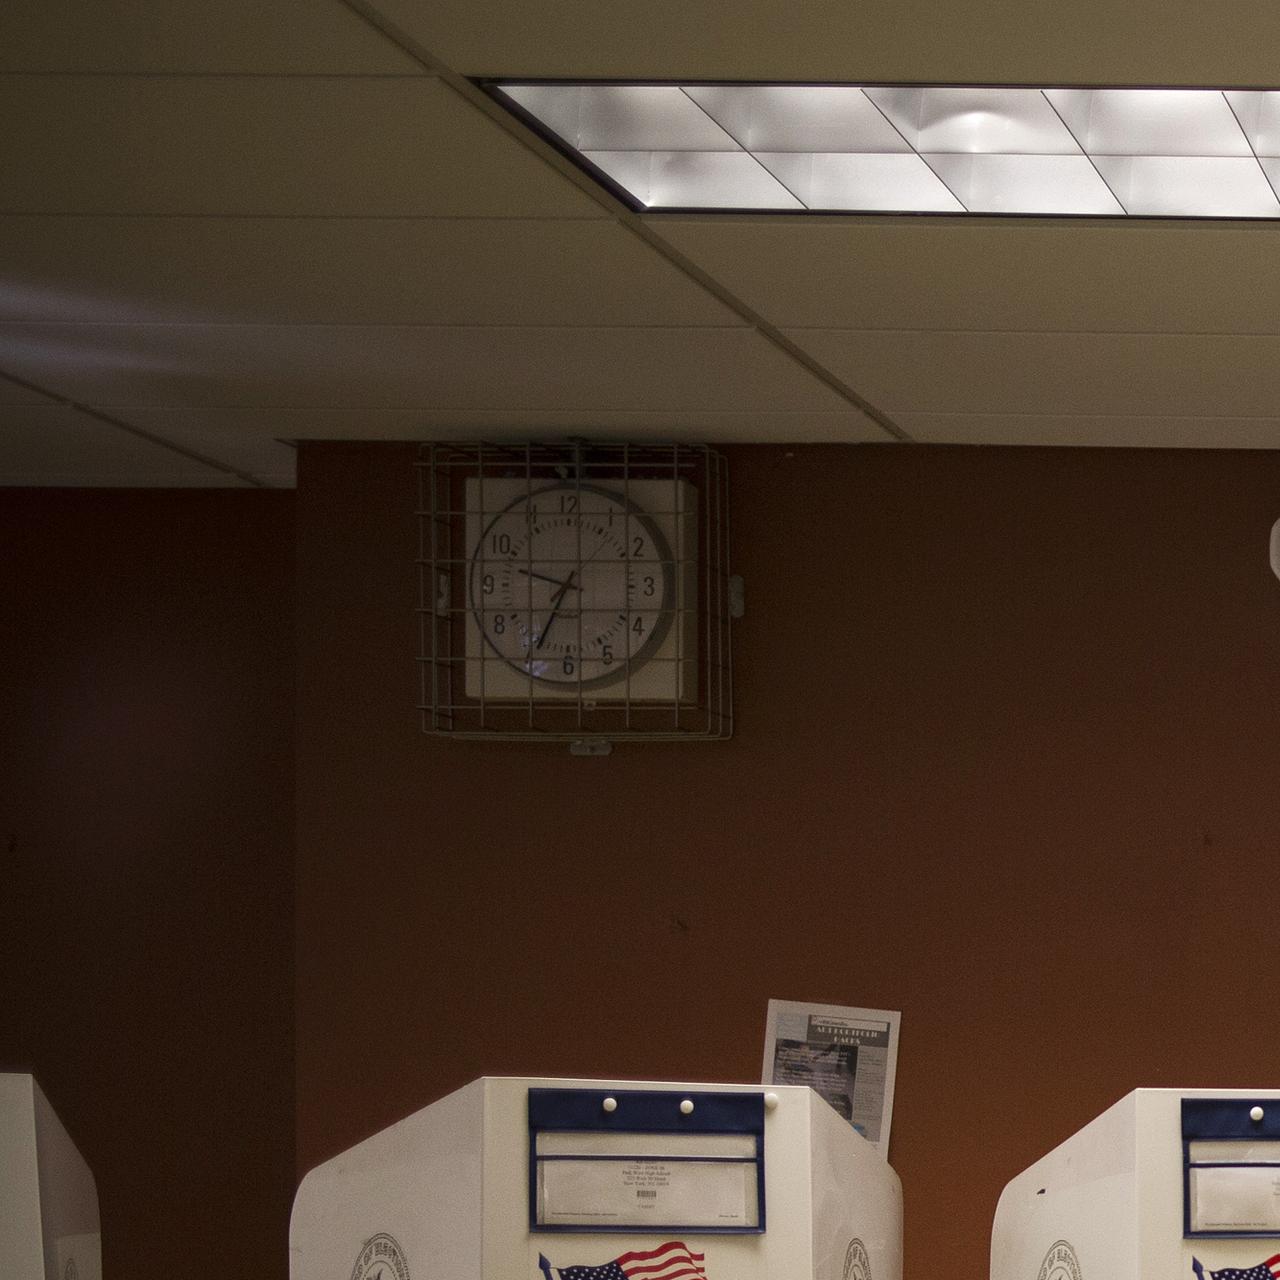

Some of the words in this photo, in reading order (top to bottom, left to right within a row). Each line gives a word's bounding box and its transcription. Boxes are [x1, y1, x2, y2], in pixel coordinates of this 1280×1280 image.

[559, 495, 578, 514] 12
[491, 534, 511, 554] 10
[633, 537, 645, 557] 2
[483, 574, 495, 595] 9
[643, 577, 655, 597] 3
[493, 614, 506, 634] 8
[631, 617, 645, 636] 4
[602, 645, 613, 665] 5
[563, 655, 575, 676] 6
